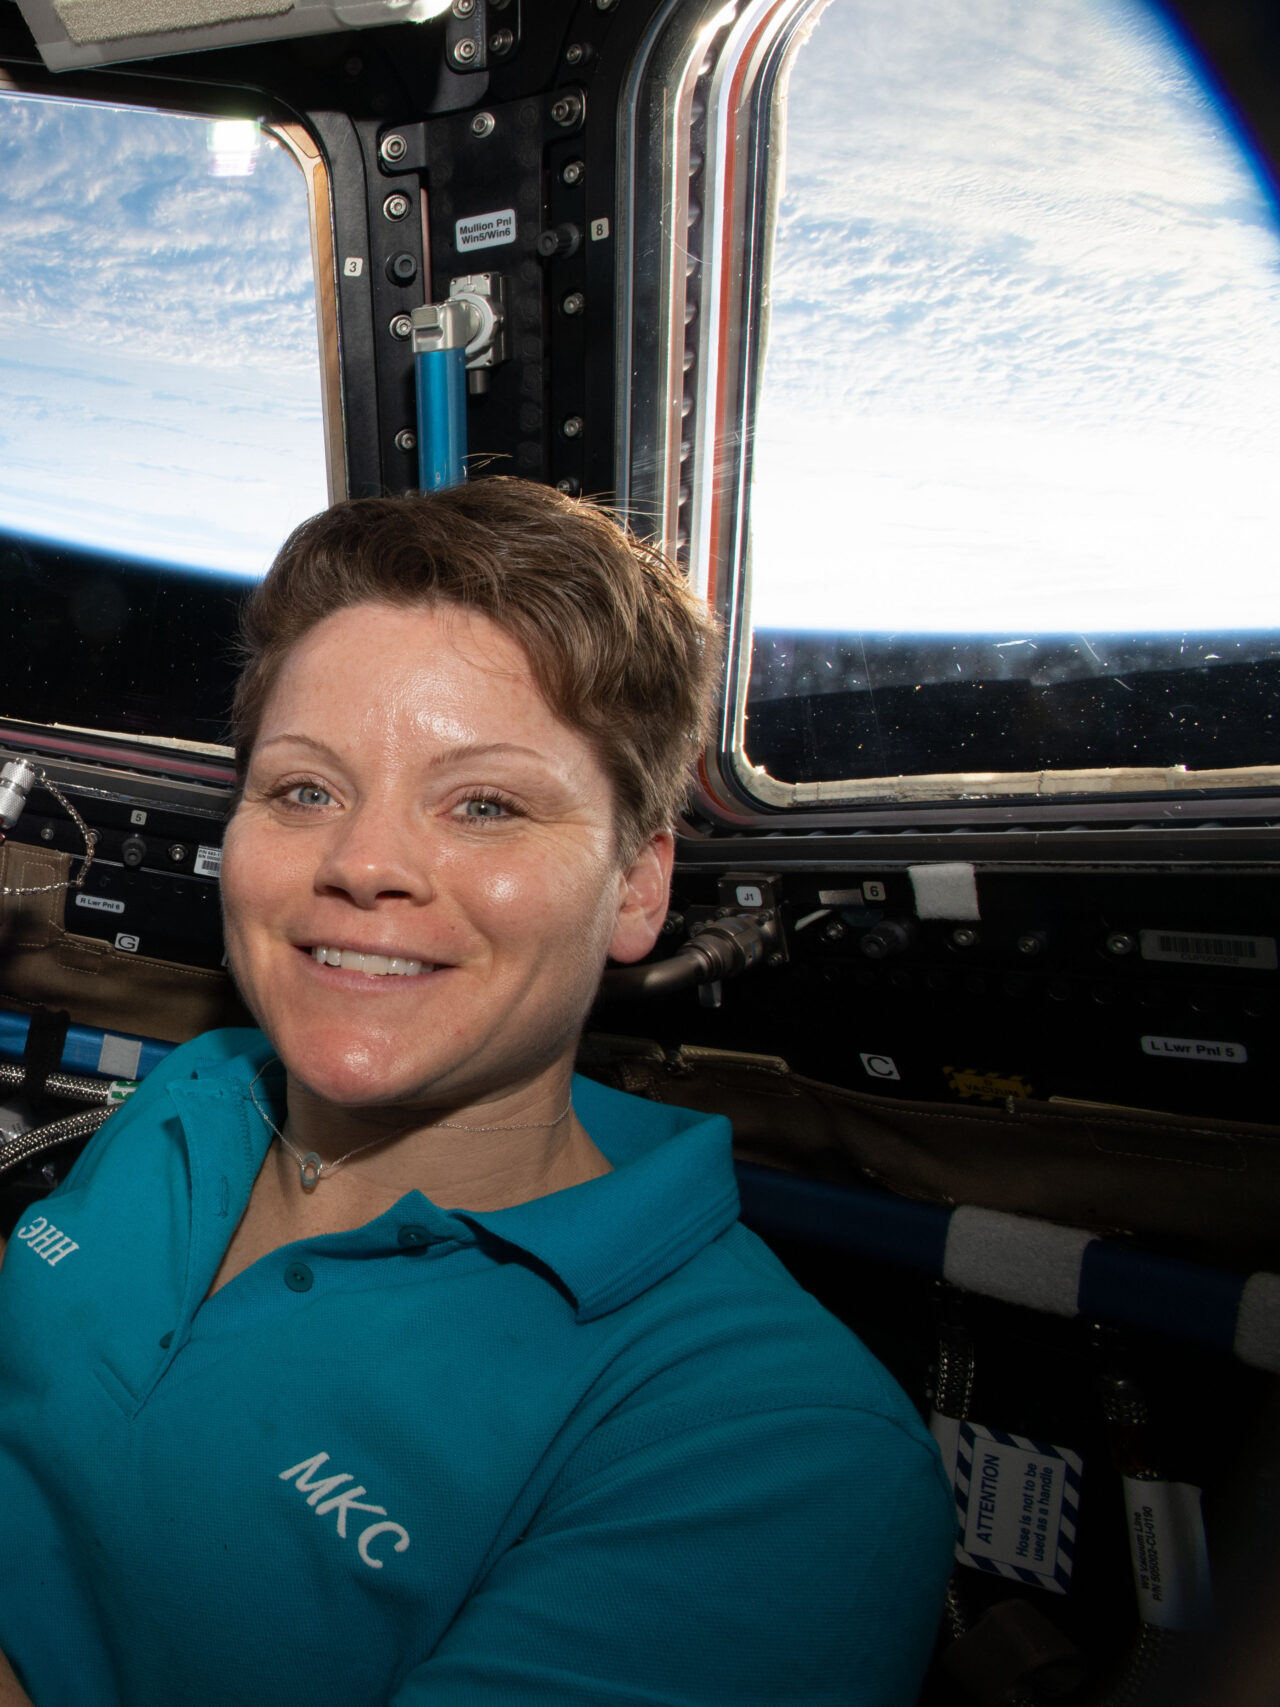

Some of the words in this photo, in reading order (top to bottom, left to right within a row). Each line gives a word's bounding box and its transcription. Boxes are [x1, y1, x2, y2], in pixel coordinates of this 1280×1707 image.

[459, 220, 494, 235] Mullion
[496, 216, 513, 227] Pnl
[595, 223, 604, 237] 8
[461, 227, 512, 244] Win5/Win6
[349, 262, 357, 273] 3
[135, 813, 142, 822] 5
[744, 892, 754, 902] J1
[870, 885, 879, 897] 6
[87, 898, 101, 907] Lwr
[102, 901, 115, 909] Pnl
[118, 935, 136, 949] G
[1150, 1040, 1161, 1050] L
[1164, 1042, 1191, 1053] Lwr
[1196, 1045, 1221, 1056] Pnl
[1225, 1048, 1234, 1057] 5
[867, 1056, 894, 1076] C
[1024, 1462, 1038, 1478] be
[1023, 1479, 1036, 1492] to
[1038, 1467, 1054, 1506] handle
[976, 1453, 1000, 1545] ATTENTION
[1021, 1493, 1033, 1512] not
[1019, 1514, 1031, 1525] is
[1039, 1506, 1049, 1516] a
[1037, 1514, 1048, 1532] as
[1133, 1511, 1144, 1532] Line
[1016, 1529, 1030, 1558] Hose
[1033, 1532, 1046, 1562] used
[1136, 1534, 1148, 1572] Vacuum
[1151, 1583, 1163, 1603] P/N
